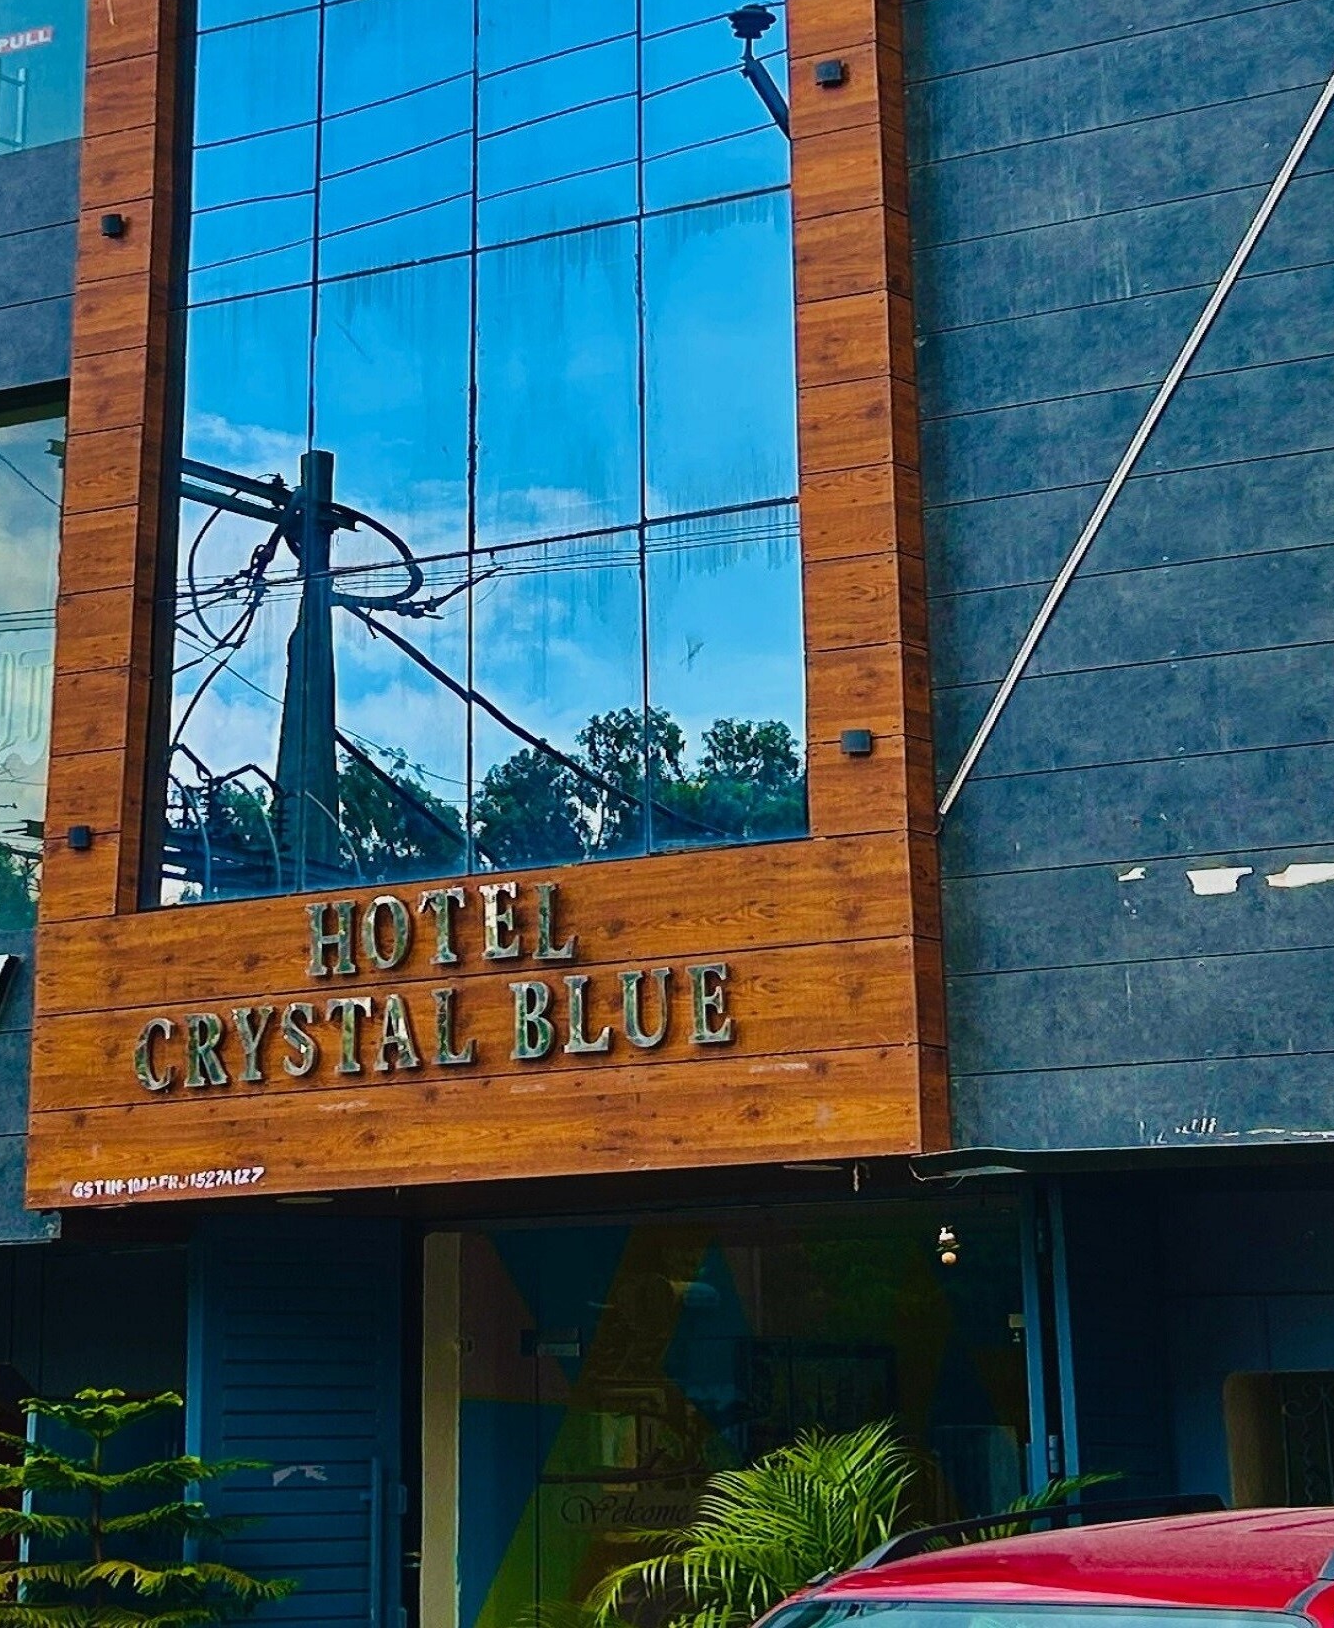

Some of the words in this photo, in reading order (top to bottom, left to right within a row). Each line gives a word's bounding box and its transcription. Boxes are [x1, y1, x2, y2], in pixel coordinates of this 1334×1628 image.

[304, 881, 579, 977] HOTEL
[133, 987, 477, 1093] CRYSTAL
[510, 962, 736, 1061] BLUE
